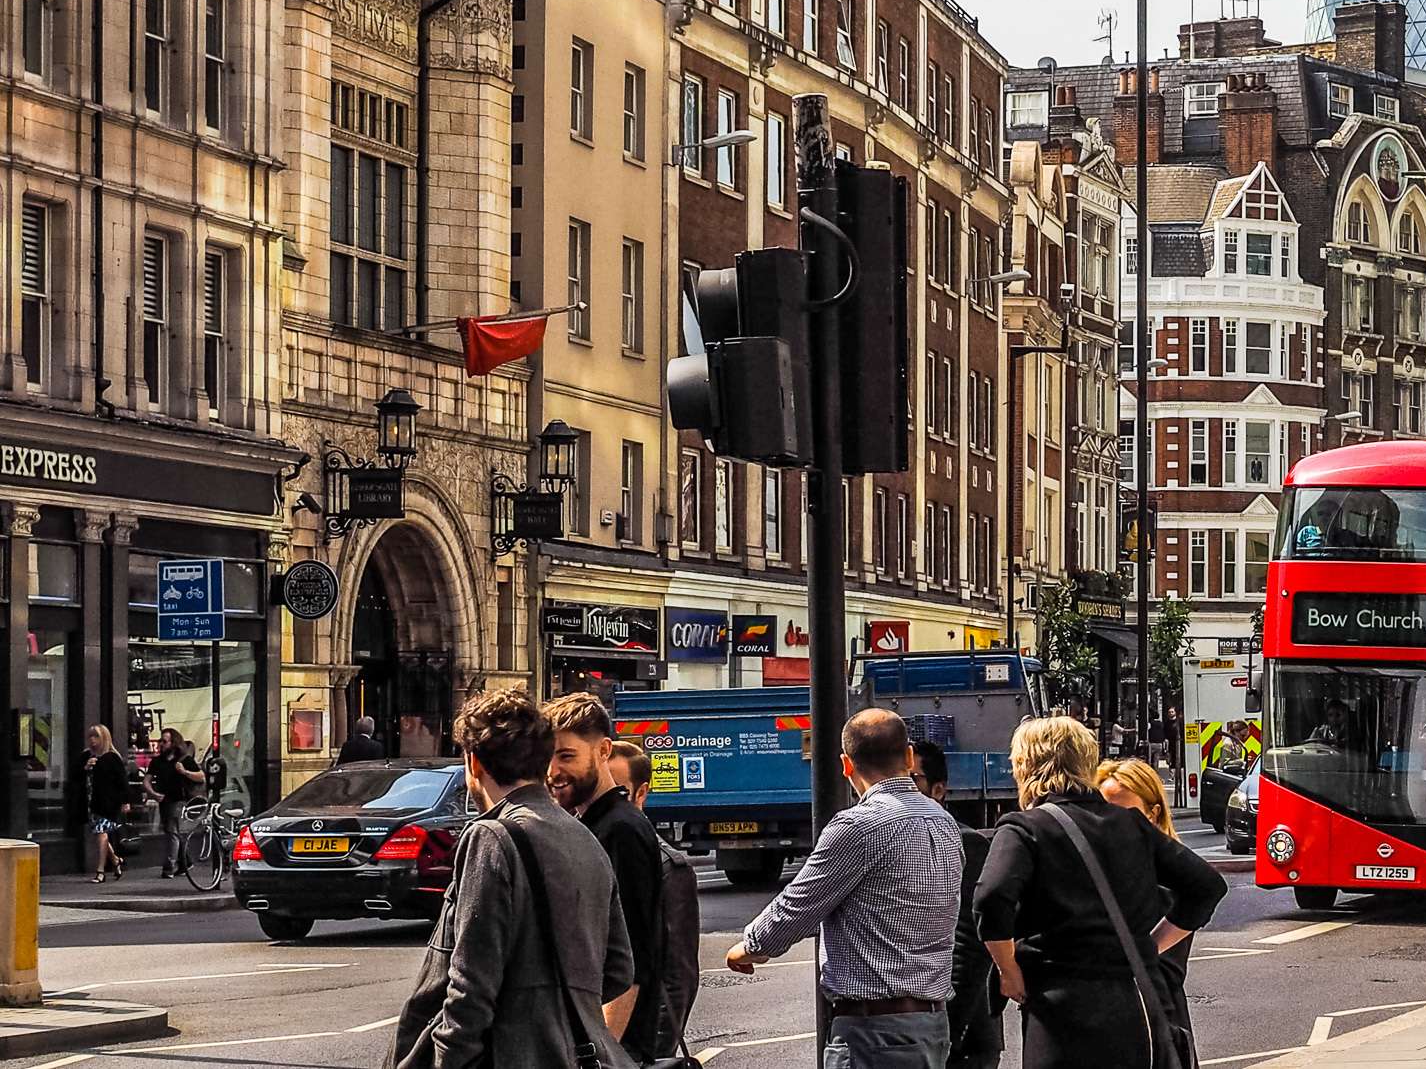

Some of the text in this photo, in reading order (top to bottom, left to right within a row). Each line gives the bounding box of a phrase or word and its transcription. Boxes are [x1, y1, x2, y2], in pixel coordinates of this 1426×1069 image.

[1, 445, 97, 484] EXPRESS
[172, 617, 210, 626] Mon Sun
[1308, 608, 1347, 627] Bow
[1356, 609, 1423, 629] Church
[737, 645, 770, 653] CORAL
[677, 735, 732, 749] Drainage
[318, 840, 338, 850] JAE
[1362, 867, 1383, 878] LTZ
